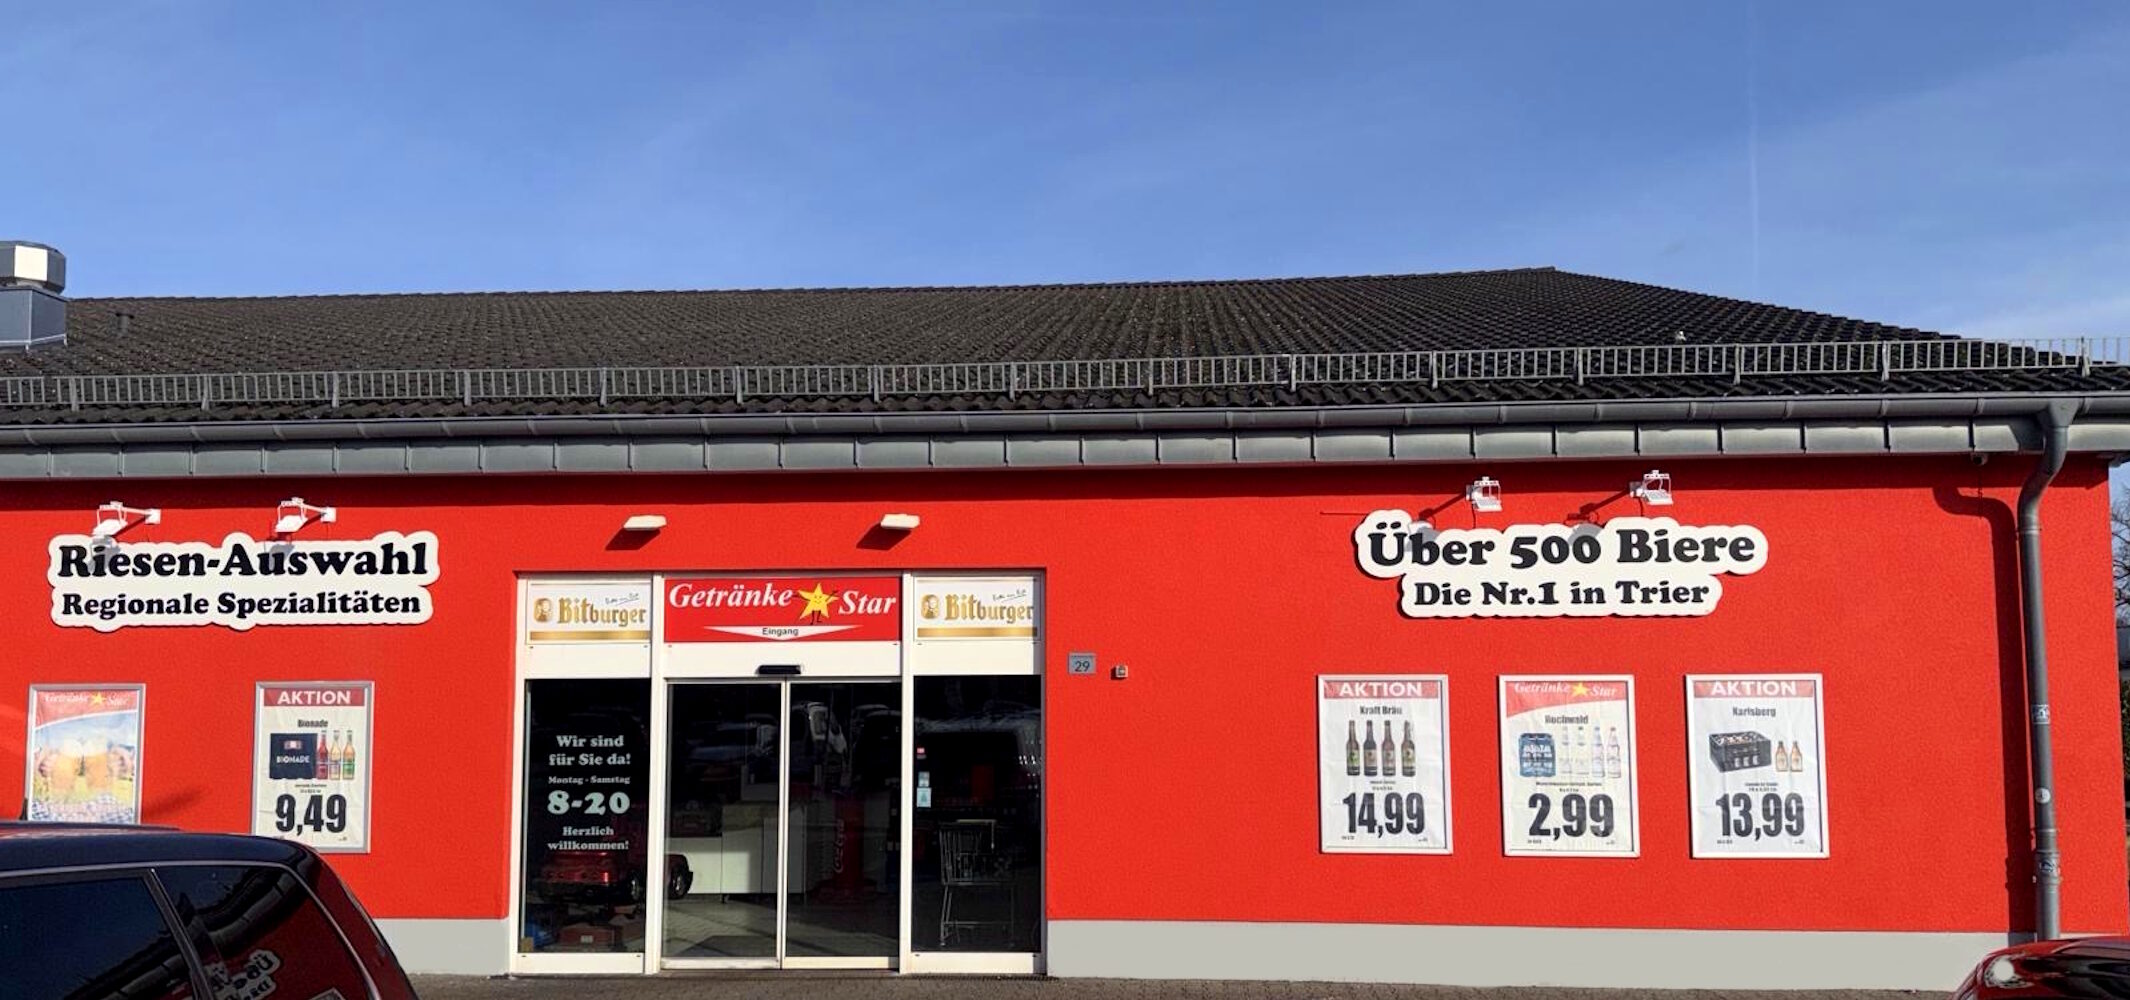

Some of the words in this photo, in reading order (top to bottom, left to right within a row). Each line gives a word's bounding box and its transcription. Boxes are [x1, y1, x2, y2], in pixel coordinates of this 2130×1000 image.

[1369, 521, 1495, 567] Über
[1510, 534, 1601, 569] 500
[1616, 528, 1756, 563] Biere
[57, 542, 427, 577] Riesen-Auswahl
[62, 592, 208, 620] Regionale
[217, 591, 421, 619] Spezialitäten
[669, 582, 794, 609] Getränke
[838, 590, 897, 615] Star
[1414, 582, 1472, 606] Die
[1481, 581, 1560, 606] Nr.1
[1570, 581, 1606, 604] in
[1615, 579, 1710, 604] Trier
[557, 597, 647, 627] Bitburger
[945, 593, 1034, 624] Bitburger
[762, 627, 799, 637] Eingang
[1074, 660, 1090, 672] 29
[277, 690, 351, 705] AKTION
[1339, 681, 1422, 697] AKTION
[1711, 680, 1798, 696] AKTION
[556, 735, 586, 747] Wir
[590, 735, 624, 747] sind
[549, 753, 575, 765] für
[578, 753, 603, 765] Sie
[607, 753, 631, 765] da!
[275, 794, 347, 835] 9,49
[547, 790, 630, 815] 8-20
[1342, 792, 1425, 838] 14,99
[1528, 793, 1614, 841] 2,99
[1715, 792, 1805, 841] 13,99
[562, 826, 615, 836] Herzlich
[547, 840, 629, 850] willkommen!
